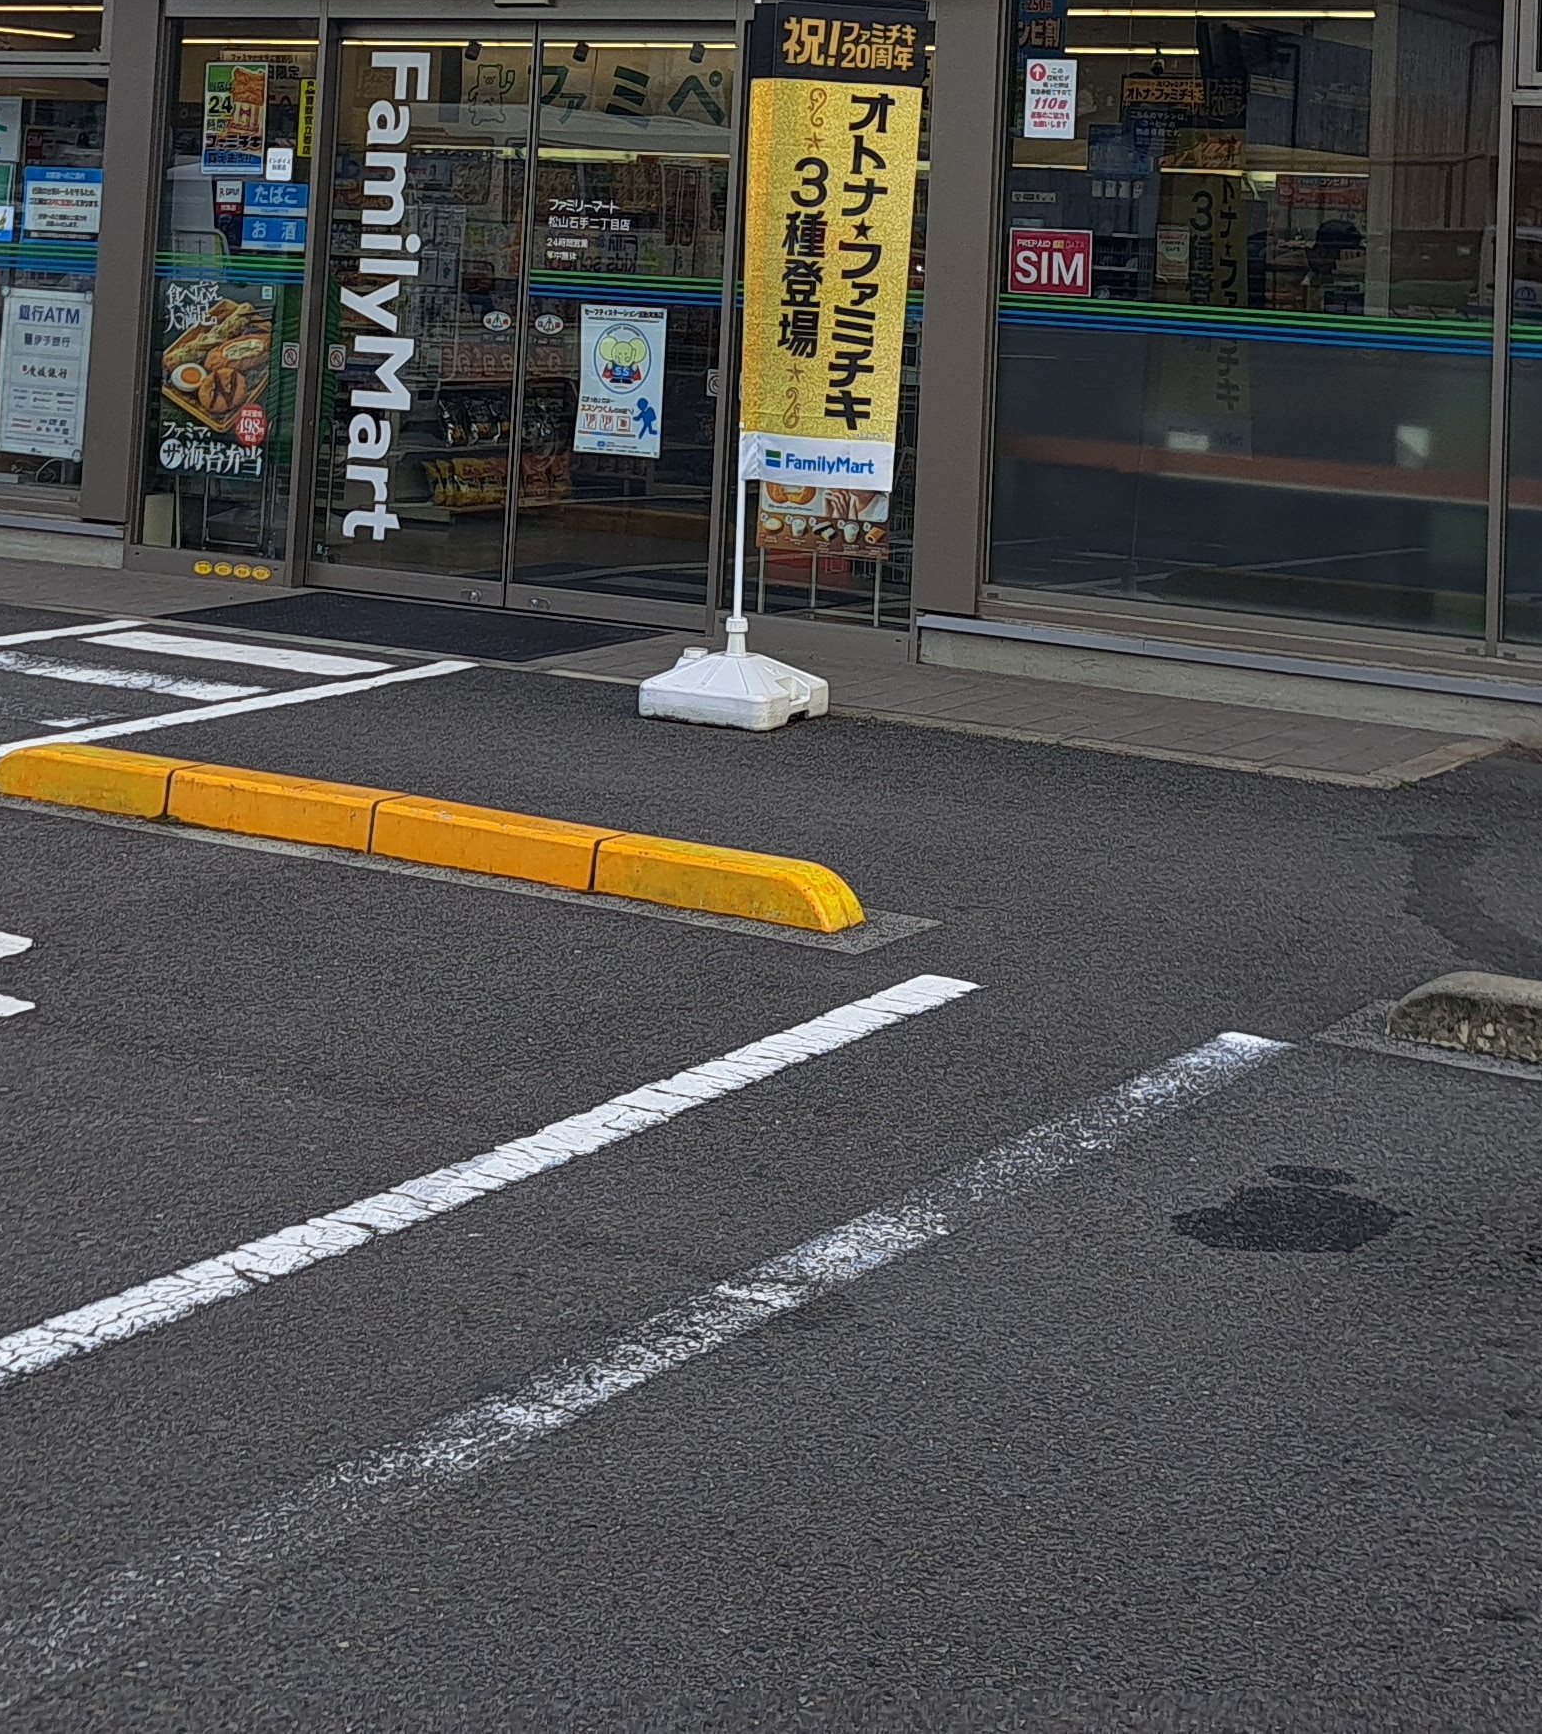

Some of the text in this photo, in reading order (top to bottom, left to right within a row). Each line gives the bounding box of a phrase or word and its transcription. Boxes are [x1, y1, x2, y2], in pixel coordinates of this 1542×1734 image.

[843, 22, 918, 46] ファミチキ
[840, 43, 916, 72] 20周年
[208, 95, 233, 115] 24
[254, 185, 298, 205] たばこ
[548, 198, 620, 214] ファミリーマート
[548, 215, 631, 232] 松山石手二丁目店
[546, 237, 589, 249] 24時間営業
[1017, 238, 1051, 249] PREPAID
[777, 156, 830, 359] 3種登場
[1014, 250, 1085, 287] SIM
[340, 51, 432, 542] FamilyMart
[18, 303, 80, 325] 銀行ATM
[785, 452, 875, 475] FamilyMart
